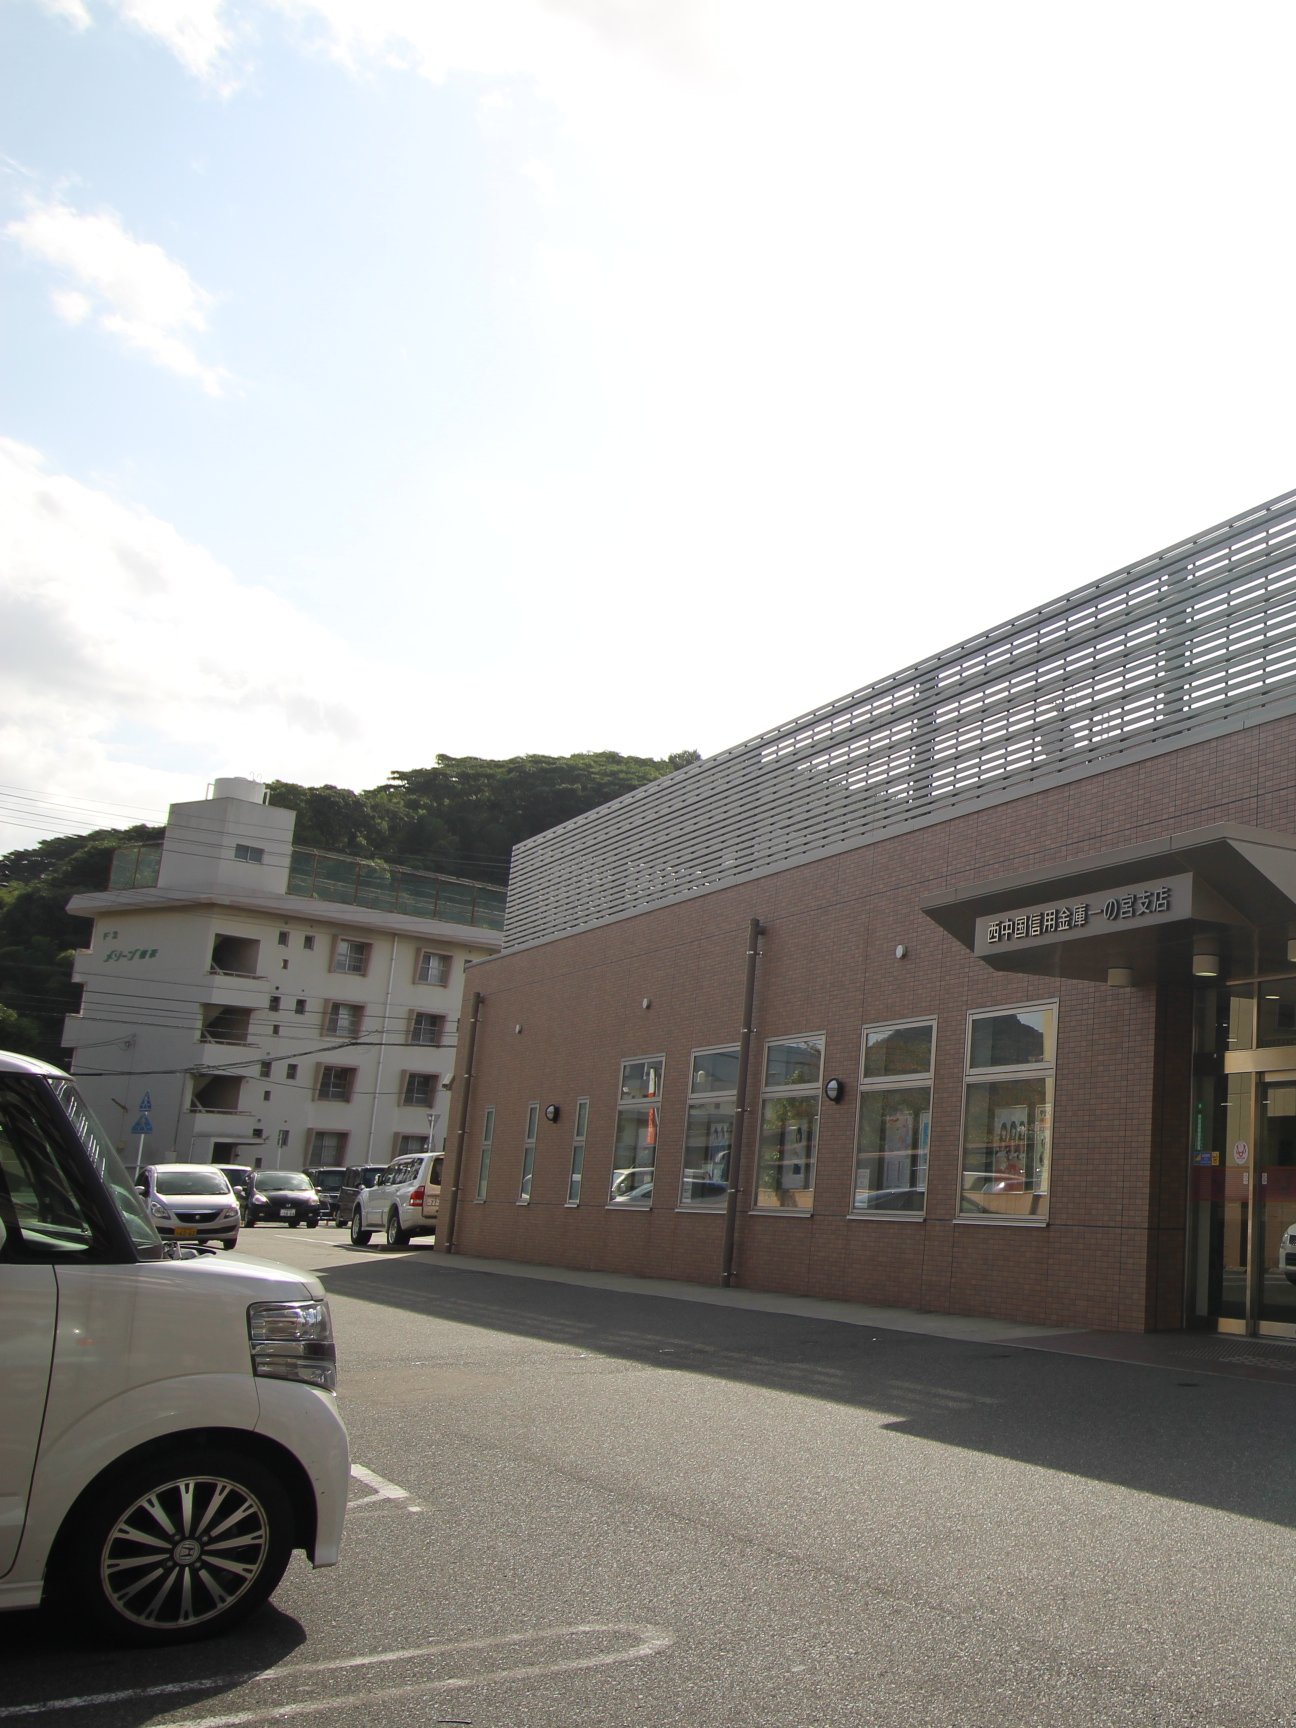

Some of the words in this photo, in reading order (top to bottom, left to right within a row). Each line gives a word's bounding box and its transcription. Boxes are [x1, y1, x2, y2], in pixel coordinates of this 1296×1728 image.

[987, 886, 1171, 943] 西中国信用金庫一の宮支店
